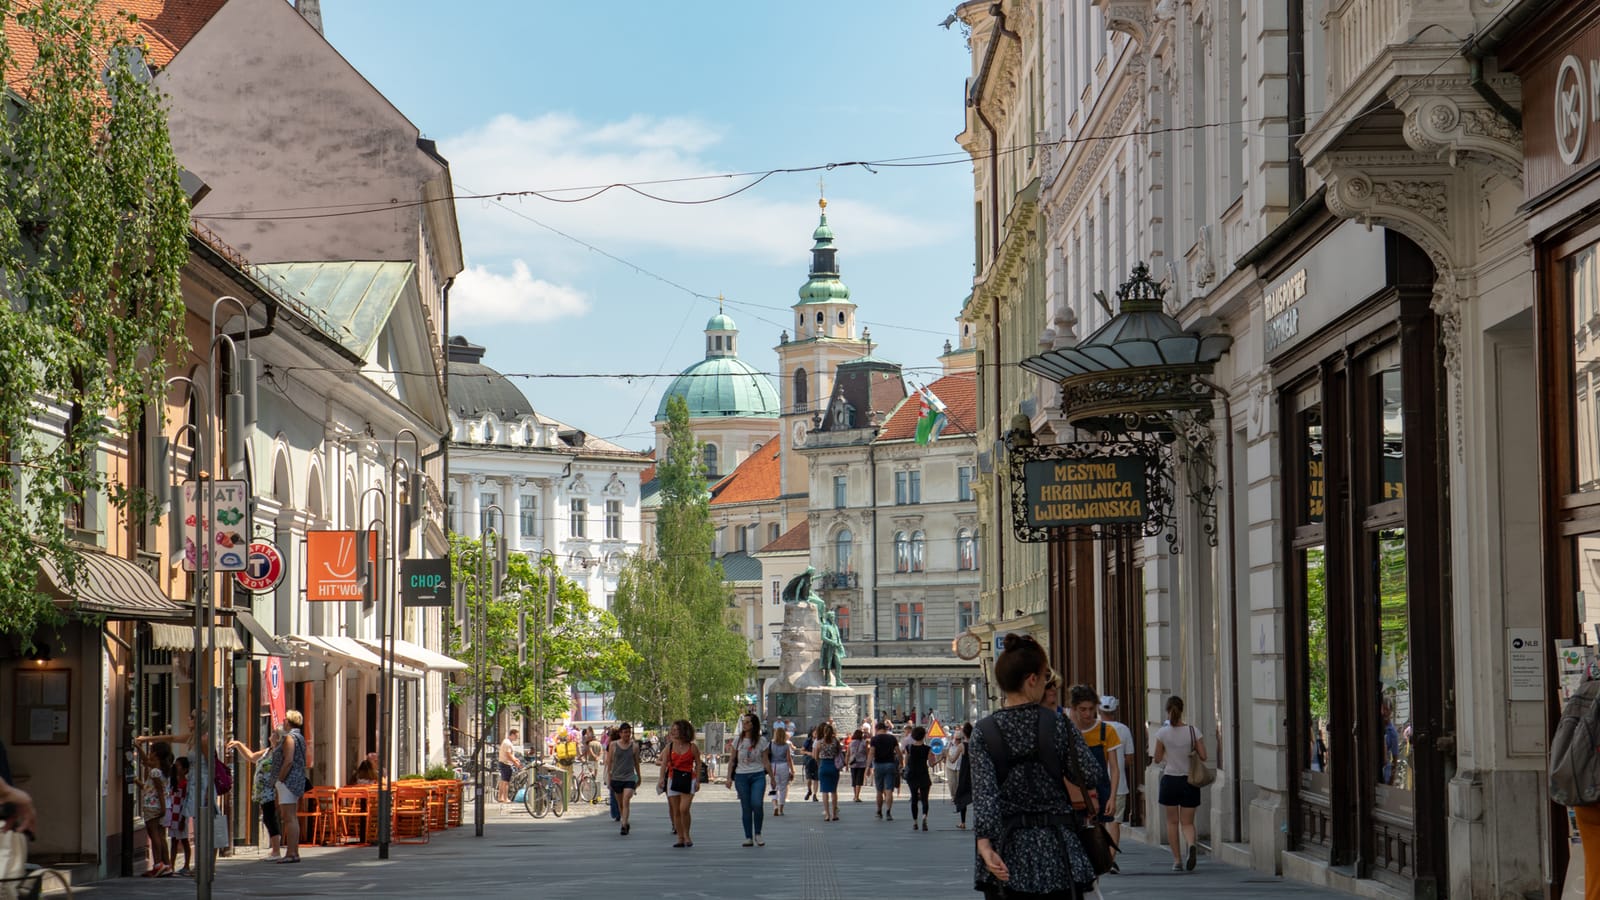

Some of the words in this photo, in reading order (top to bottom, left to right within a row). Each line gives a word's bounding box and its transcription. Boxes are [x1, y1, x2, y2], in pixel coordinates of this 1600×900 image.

[1054, 463, 1117, 481] MESTNA
[1041, 481, 1133, 502] HRANILNICA
[1035, 500, 1141, 521] LJUBLJANSKA
[250, 558, 265, 577] T
[319, 584, 361, 596] HIT'WO
[411, 574, 441, 592] CHOP
